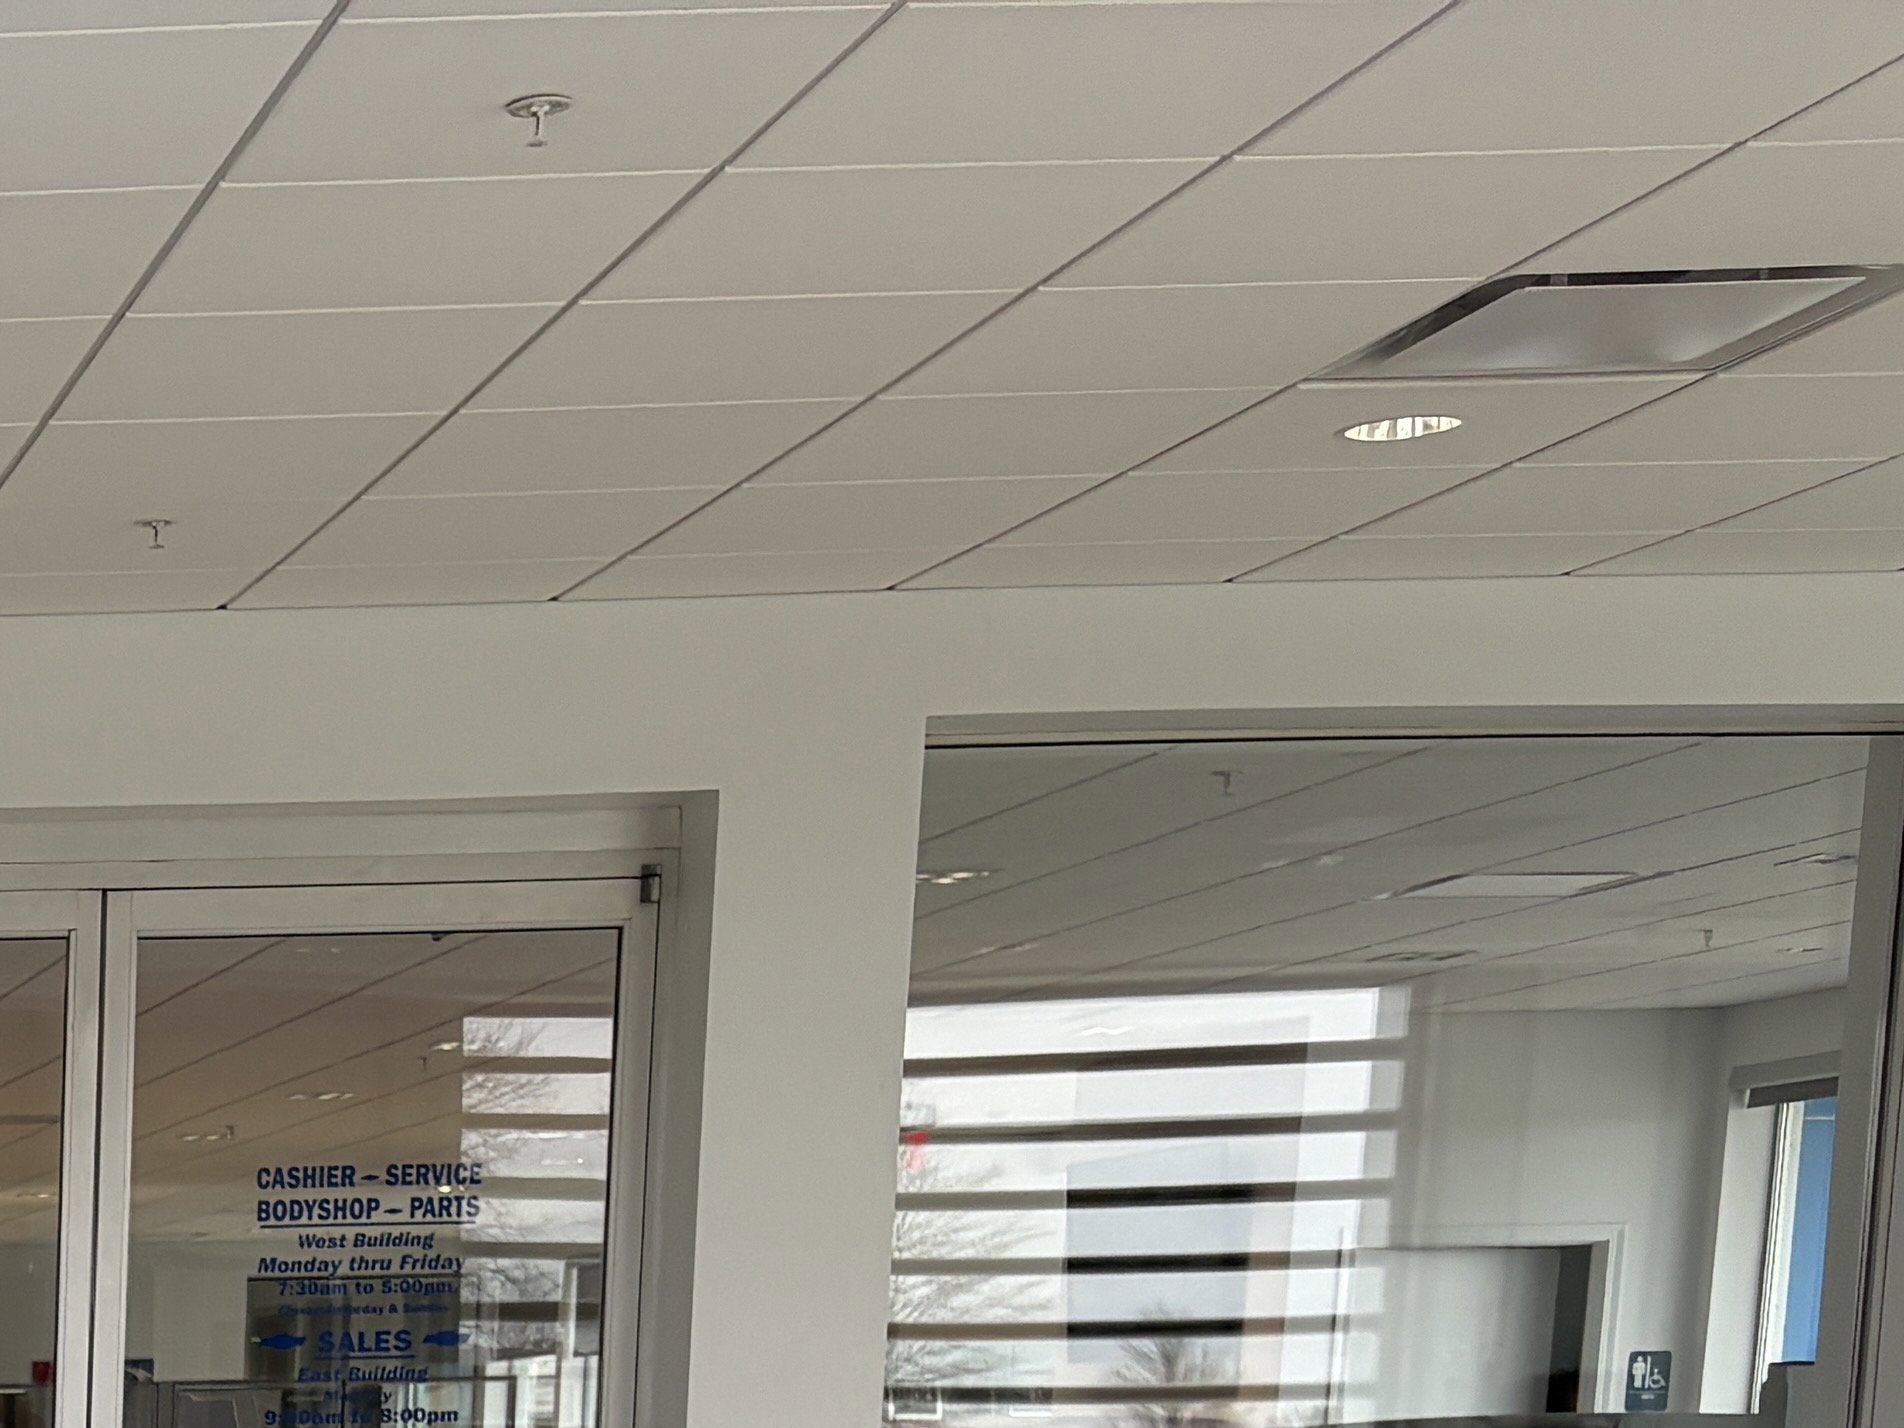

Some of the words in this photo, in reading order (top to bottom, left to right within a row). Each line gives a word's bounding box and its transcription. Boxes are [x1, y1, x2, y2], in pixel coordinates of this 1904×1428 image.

[256, 1165, 356, 1190] CASHIER
[385, 1163, 482, 1187] SERVICE
[257, 1198, 380, 1222] BODYSHOP
[409, 1196, 480, 1219] PARTS
[298, 1233, 346, 1249] West
[353, 1232, 435, 1250] Building
[258, 1257, 342, 1279] Monday
[349, 1256, 392, 1272] thru
[400, 1254, 466, 1277] Friday
[355, 1281, 374, 1296] to
[318, 1330, 413, 1353] SALES
